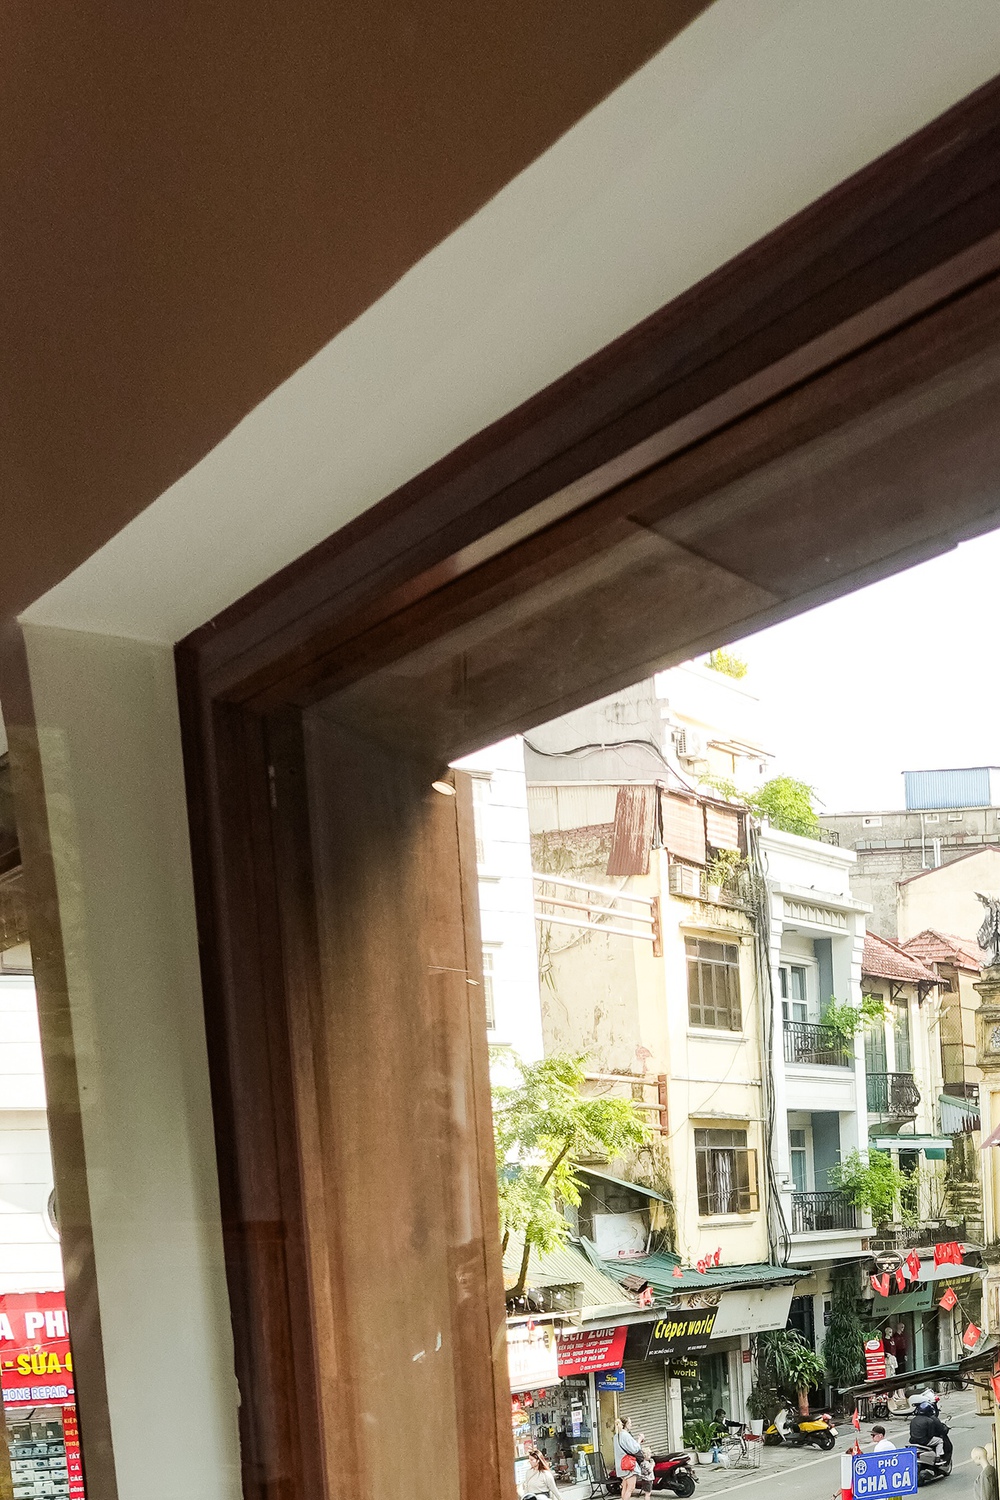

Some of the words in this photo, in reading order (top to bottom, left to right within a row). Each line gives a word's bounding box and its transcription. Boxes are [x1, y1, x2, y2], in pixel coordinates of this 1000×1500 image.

[687, 1313, 716, 1336] world
[17, 1344, 62, 1376] SỬA
[673, 1369, 696, 1377] world
[31, 1385, 68, 1400] REPAIR
[878, 1454, 899, 1468] PHỐ
[857, 1468, 888, 1494] CHẢ
[892, 1467, 911, 1489] CÁ
